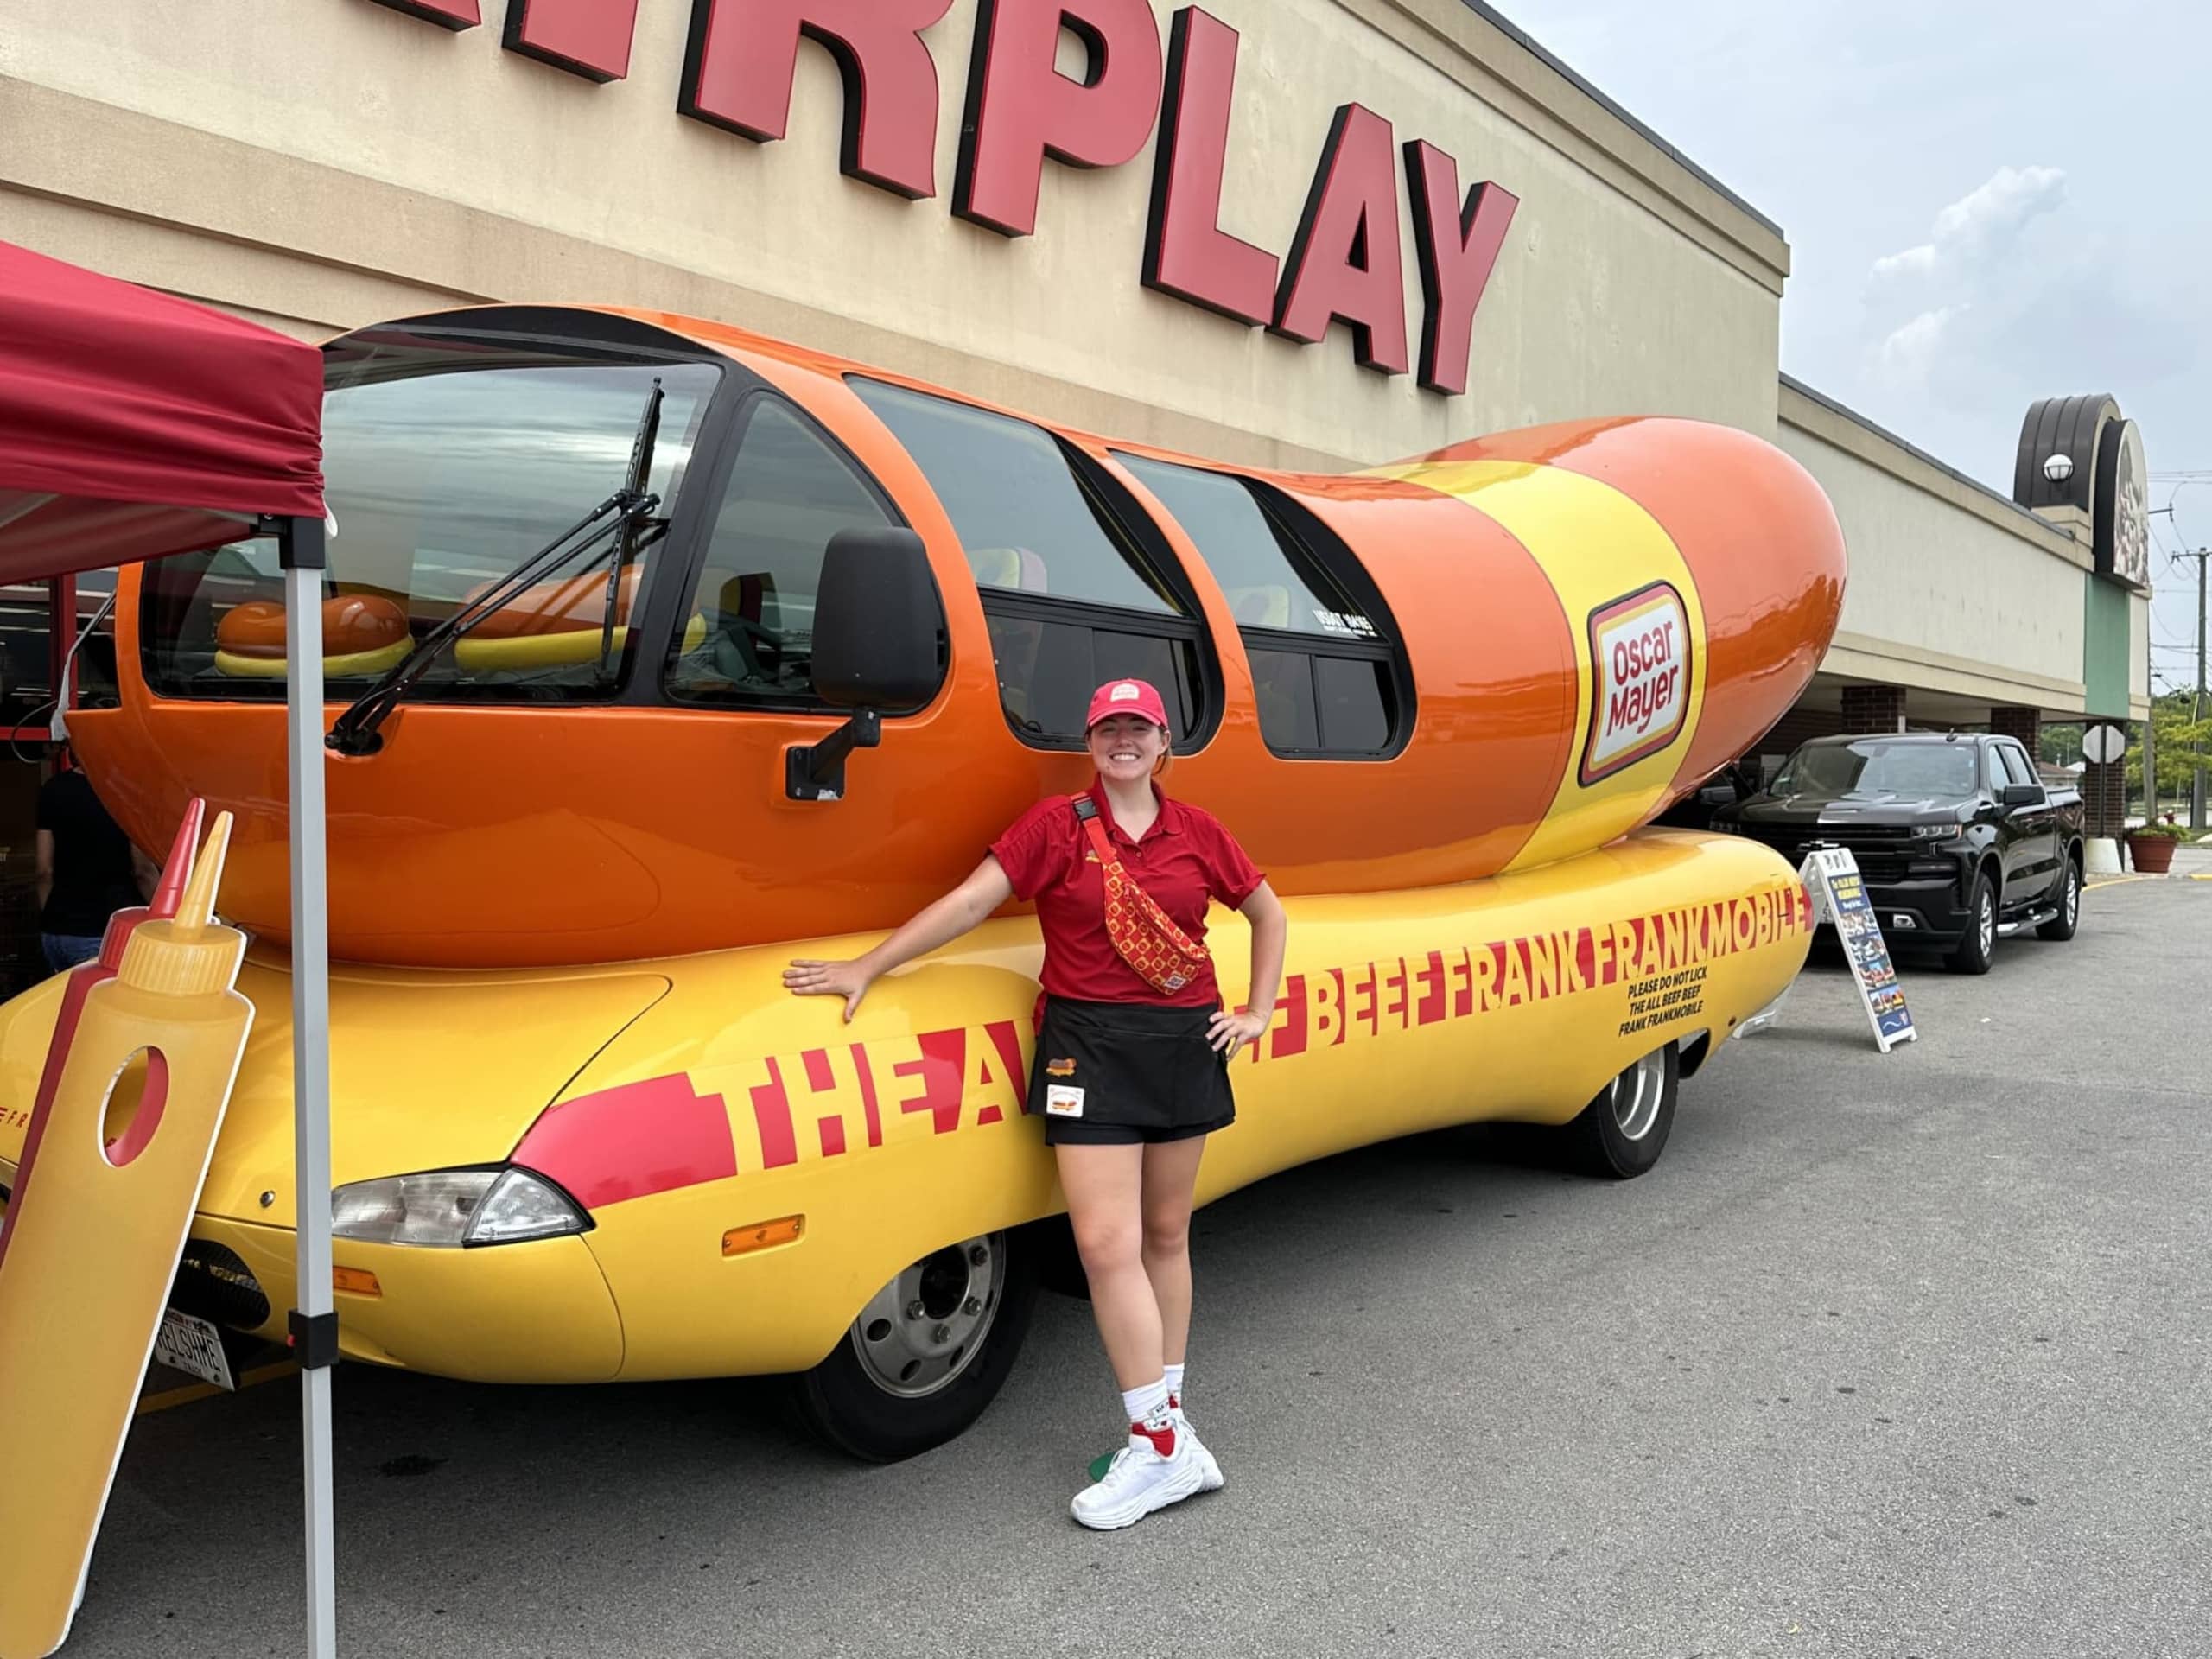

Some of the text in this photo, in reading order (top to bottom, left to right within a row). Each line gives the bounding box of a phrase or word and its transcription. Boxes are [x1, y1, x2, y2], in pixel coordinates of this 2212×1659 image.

[1613, 620, 1673, 686] Oscar
[1606, 664, 1679, 737] Mayer
[1628, 965, 1707, 999] PLEASE DO NOT LICK
[1630, 983, 1701, 1016] THE ALL BEEF BEEF
[686, 1034, 935, 1176] THE
[1306, 952, 1431, 1051] BEEF
[1443, 930, 1587, 1020] FRANK
[1591, 885, 1809, 986] FRANKMOBILE
[1618, 999, 1704, 1037] FRANK FRANKMOBILE
